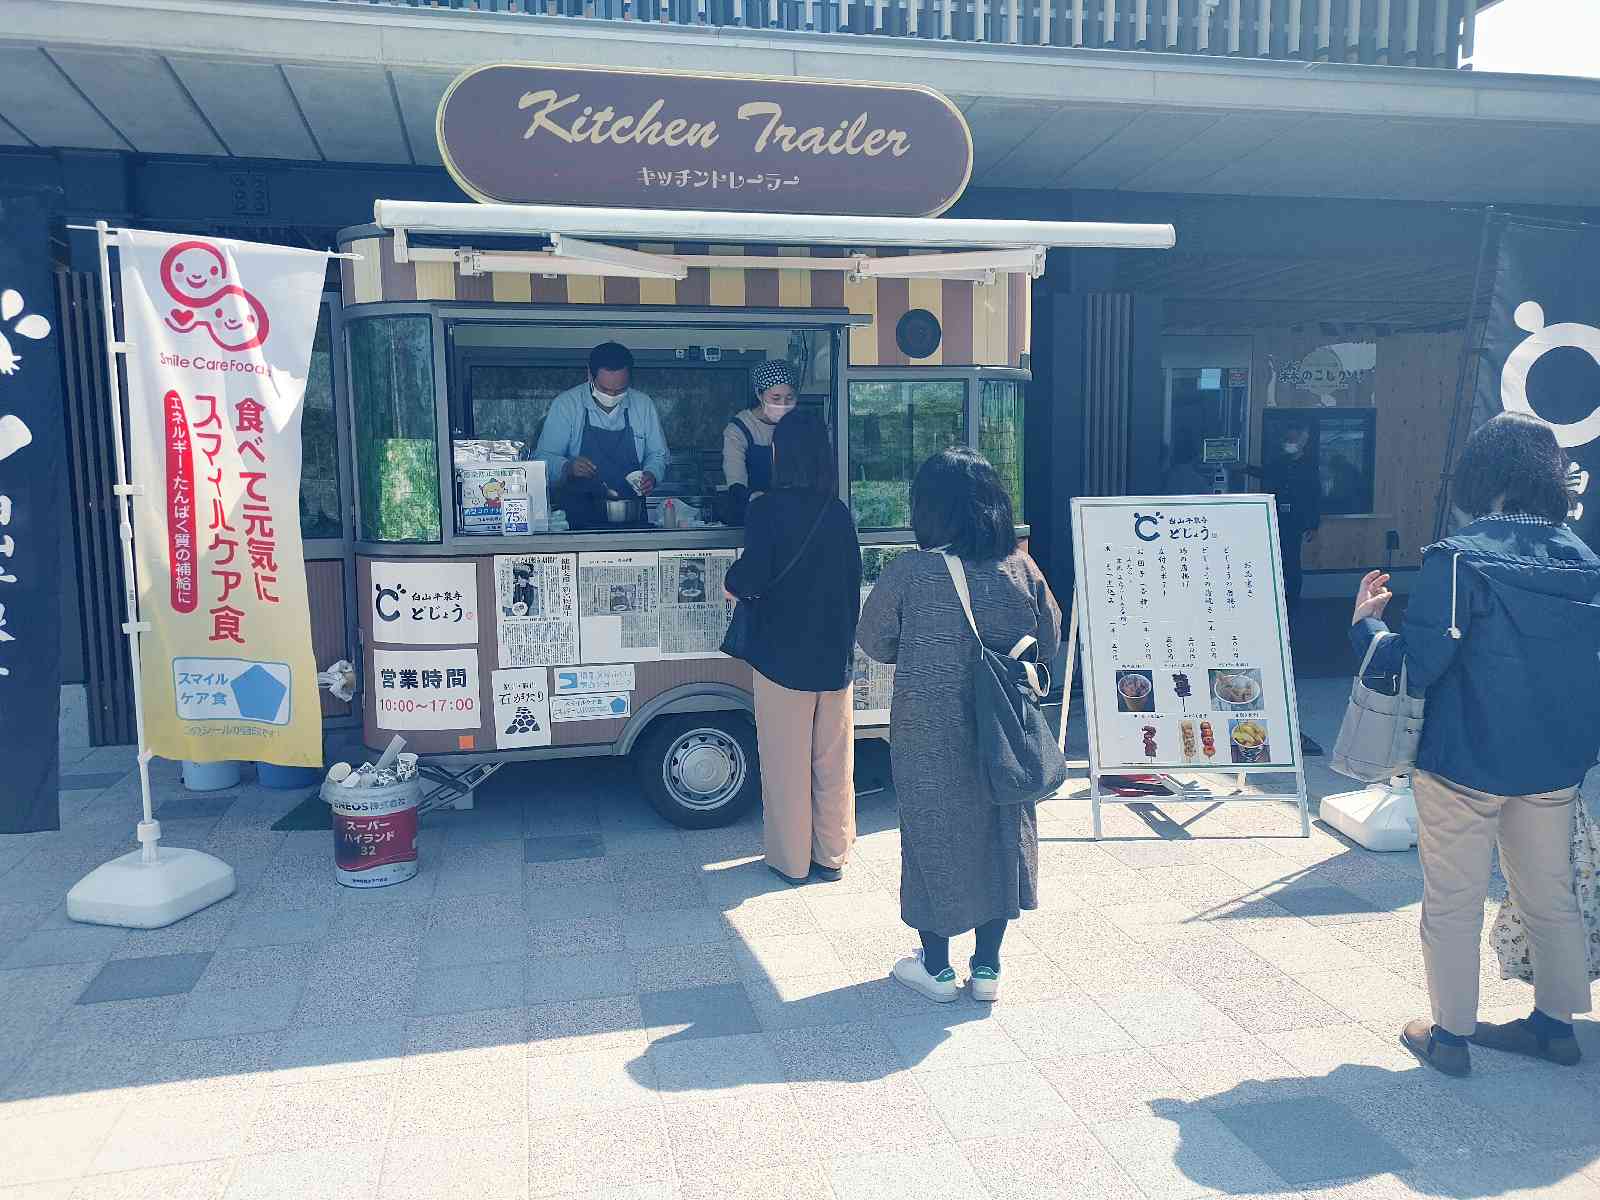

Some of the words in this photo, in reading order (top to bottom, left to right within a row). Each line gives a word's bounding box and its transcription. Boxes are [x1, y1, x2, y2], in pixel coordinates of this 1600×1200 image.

[518, 89, 720, 150] Kitchen
[737, 101, 911, 158] Trailer
[638, 166, 801, 191] キッチントレーラー
[159, 351, 190, 368] Smile
[192, 356, 229, 372] Care
[234, 397, 280, 603] 食べて元気に
[193, 394, 246, 644] スマイルケア食
[1169, 526, 1209, 541] どじょう
[411, 604, 464, 622] どじょう
[178, 672, 229, 686] スマイル
[380, 668, 467, 689] 営業時間
[180, 691, 227, 706] ケア食
[346, 820, 391, 831] スーパー
[344, 831, 395, 844] ハイランド
[360, 846, 377, 856] 32
